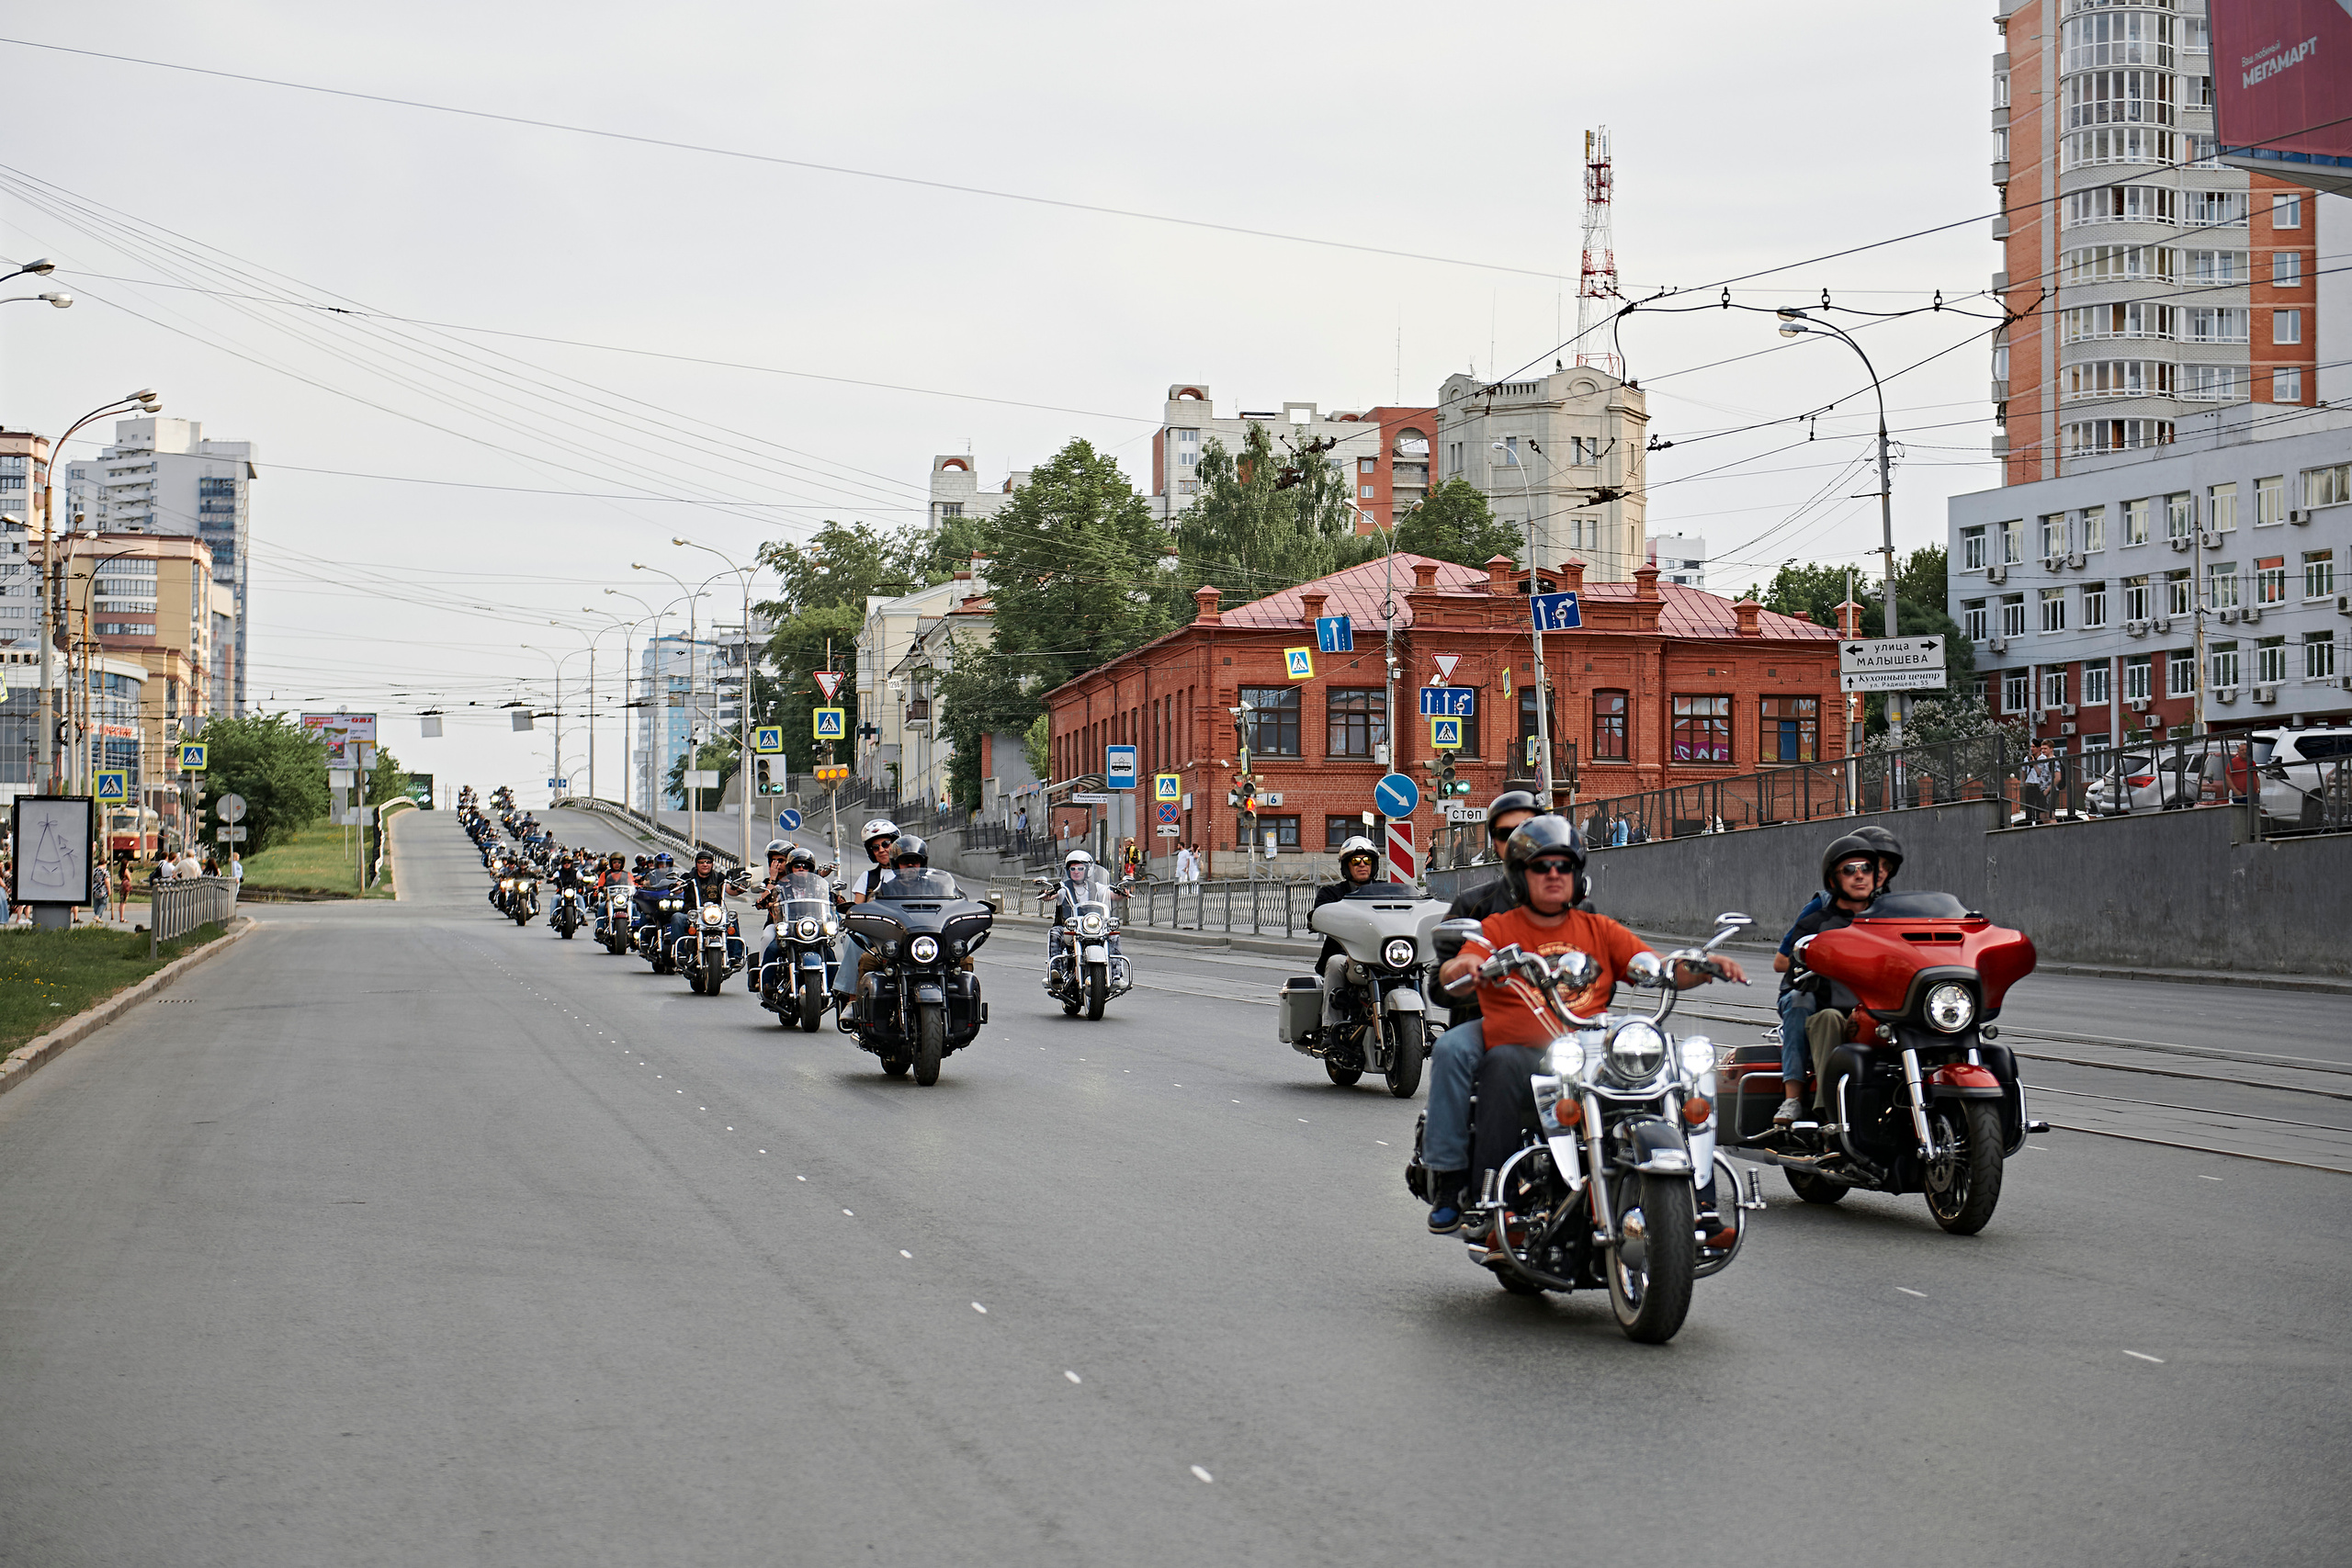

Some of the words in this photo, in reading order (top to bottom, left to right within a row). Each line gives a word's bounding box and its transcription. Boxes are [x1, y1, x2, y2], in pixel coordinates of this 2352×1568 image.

[2255, 39, 2280, 61] любимый
[2243, 36, 2317, 89] МЕГАМАРТ
[1874, 643, 1909, 653] улица
[1857, 654, 1928, 666] МАЛЫШЕВА
[1859, 673, 1906, 683] Кухонный
[1908, 672, 1940, 681] центр
[1271, 795, 1277, 804] 6
[1453, 809, 1482, 819] СТОП
